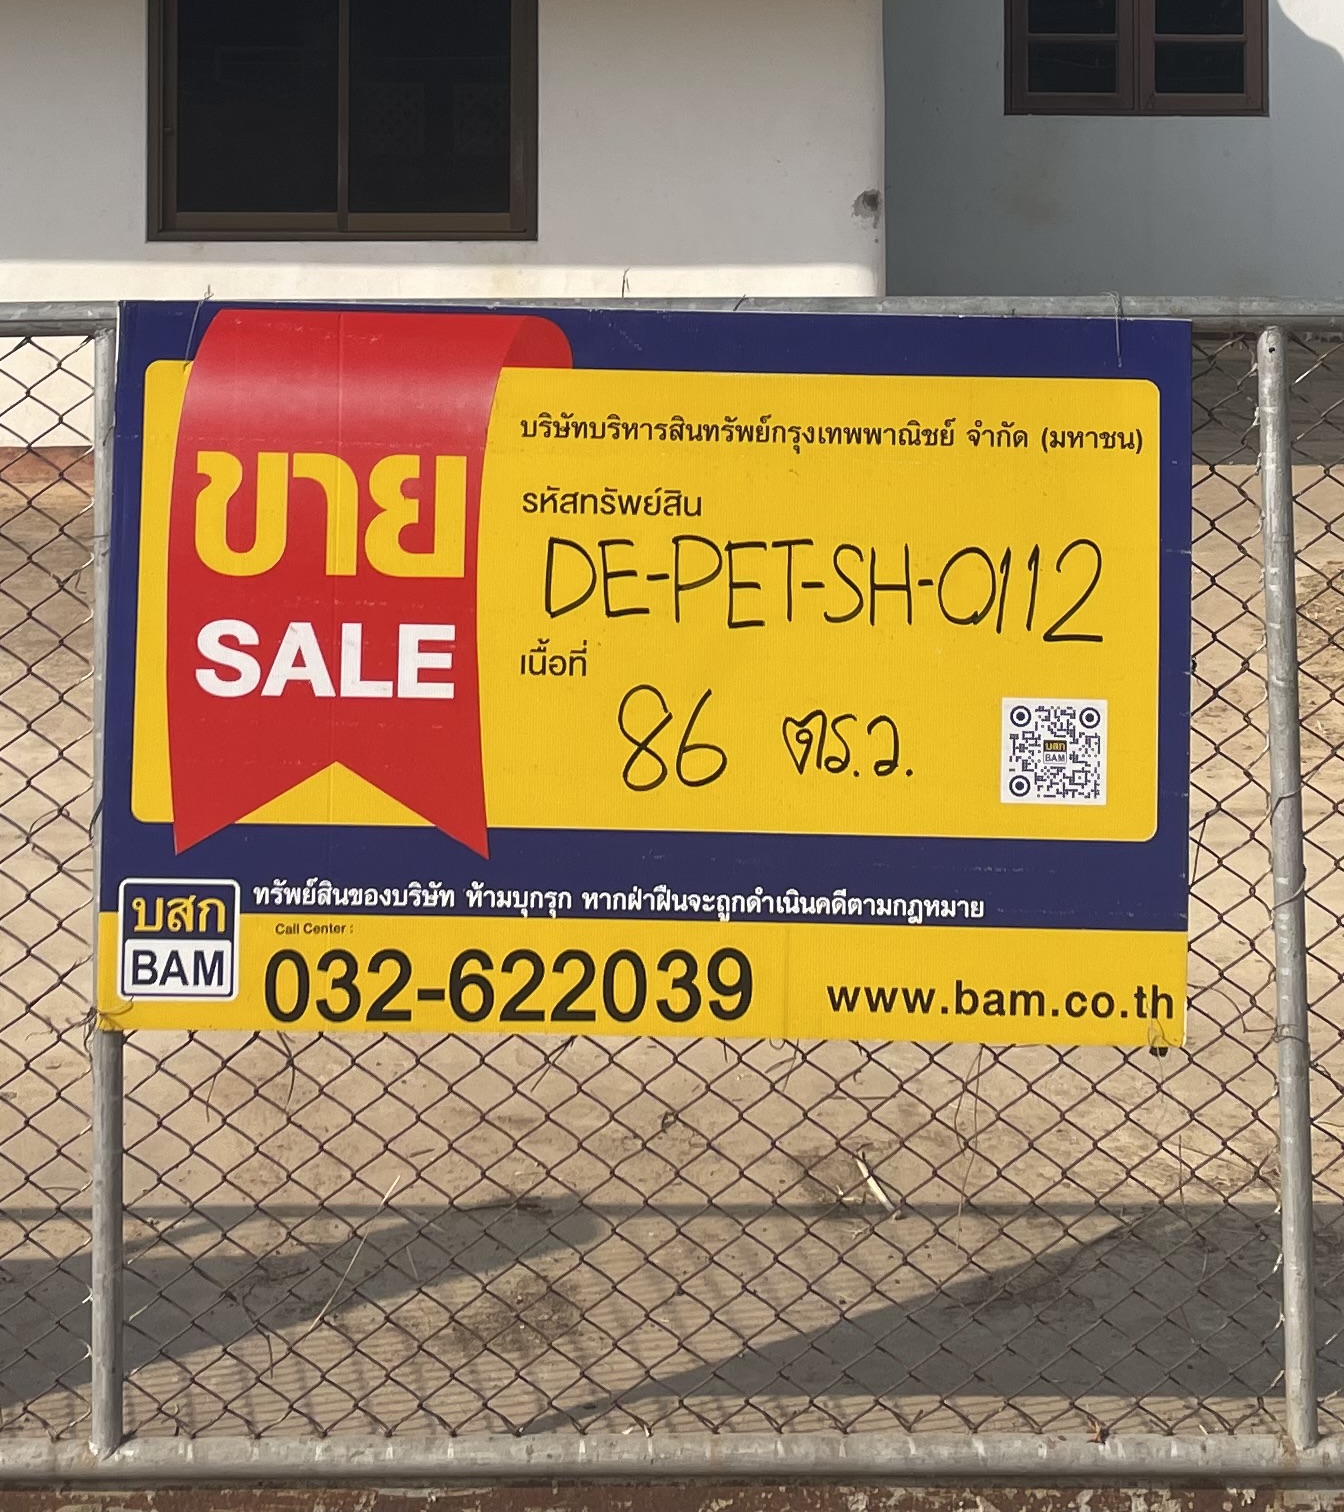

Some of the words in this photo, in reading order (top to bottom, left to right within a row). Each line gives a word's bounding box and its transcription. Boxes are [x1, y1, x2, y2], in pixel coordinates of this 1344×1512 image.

[520, 411, 956, 455] บริษัทบริหารสินทรัพย์กรุงเทพพาณิชย์
[966, 419, 1029, 449] จำกัด
[1041, 427, 1144, 455] (มหาชน)
[194, 450, 467, 578] ขาย
[522, 485, 703, 517] รหัสทรัพย์สิน
[544, 534, 1104, 643] DE-PET-SH-0112
[194, 618, 456, 700] SALE
[520, 638, 588, 678] เนื้อที่
[617, 683, 728, 792] 86
[1044, 753, 1066, 762] BAM
[131, 894, 227, 933] บสก
[253, 877, 455, 908] ทรัพย์สินของบริษัท
[465, 880, 572, 918] ห้ามบุกรุก
[581, 884, 986, 923] หากฝ่าฝืนจะถูกดำเนินคดีตามกฎหมาย
[275, 922, 300, 935] Call
[302, 922, 347, 935] Center
[130, 948, 225, 987] BAM
[264, 948, 754, 1024] 032-622039
[826, 979, 1175, 1019] www.bam.co.th
